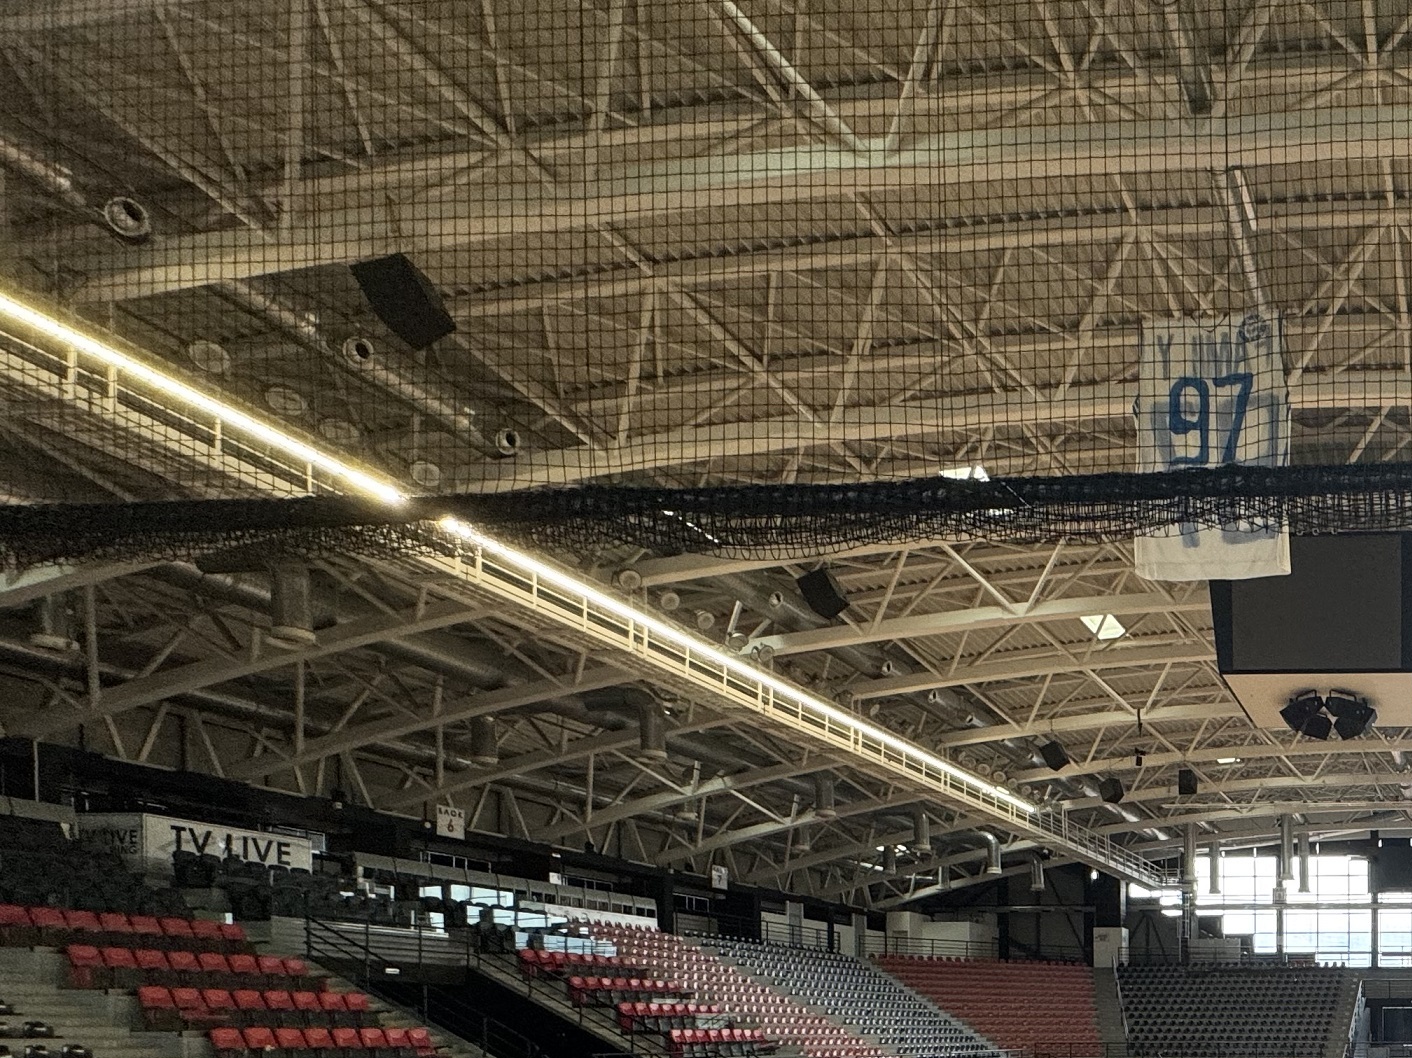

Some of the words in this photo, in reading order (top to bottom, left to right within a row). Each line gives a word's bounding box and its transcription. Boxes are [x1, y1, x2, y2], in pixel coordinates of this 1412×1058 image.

[1168, 372, 1253, 465] 97
[170, 825, 212, 853] TV
[225, 833, 291, 866] LIVE
[447, 819, 454, 832] 6
